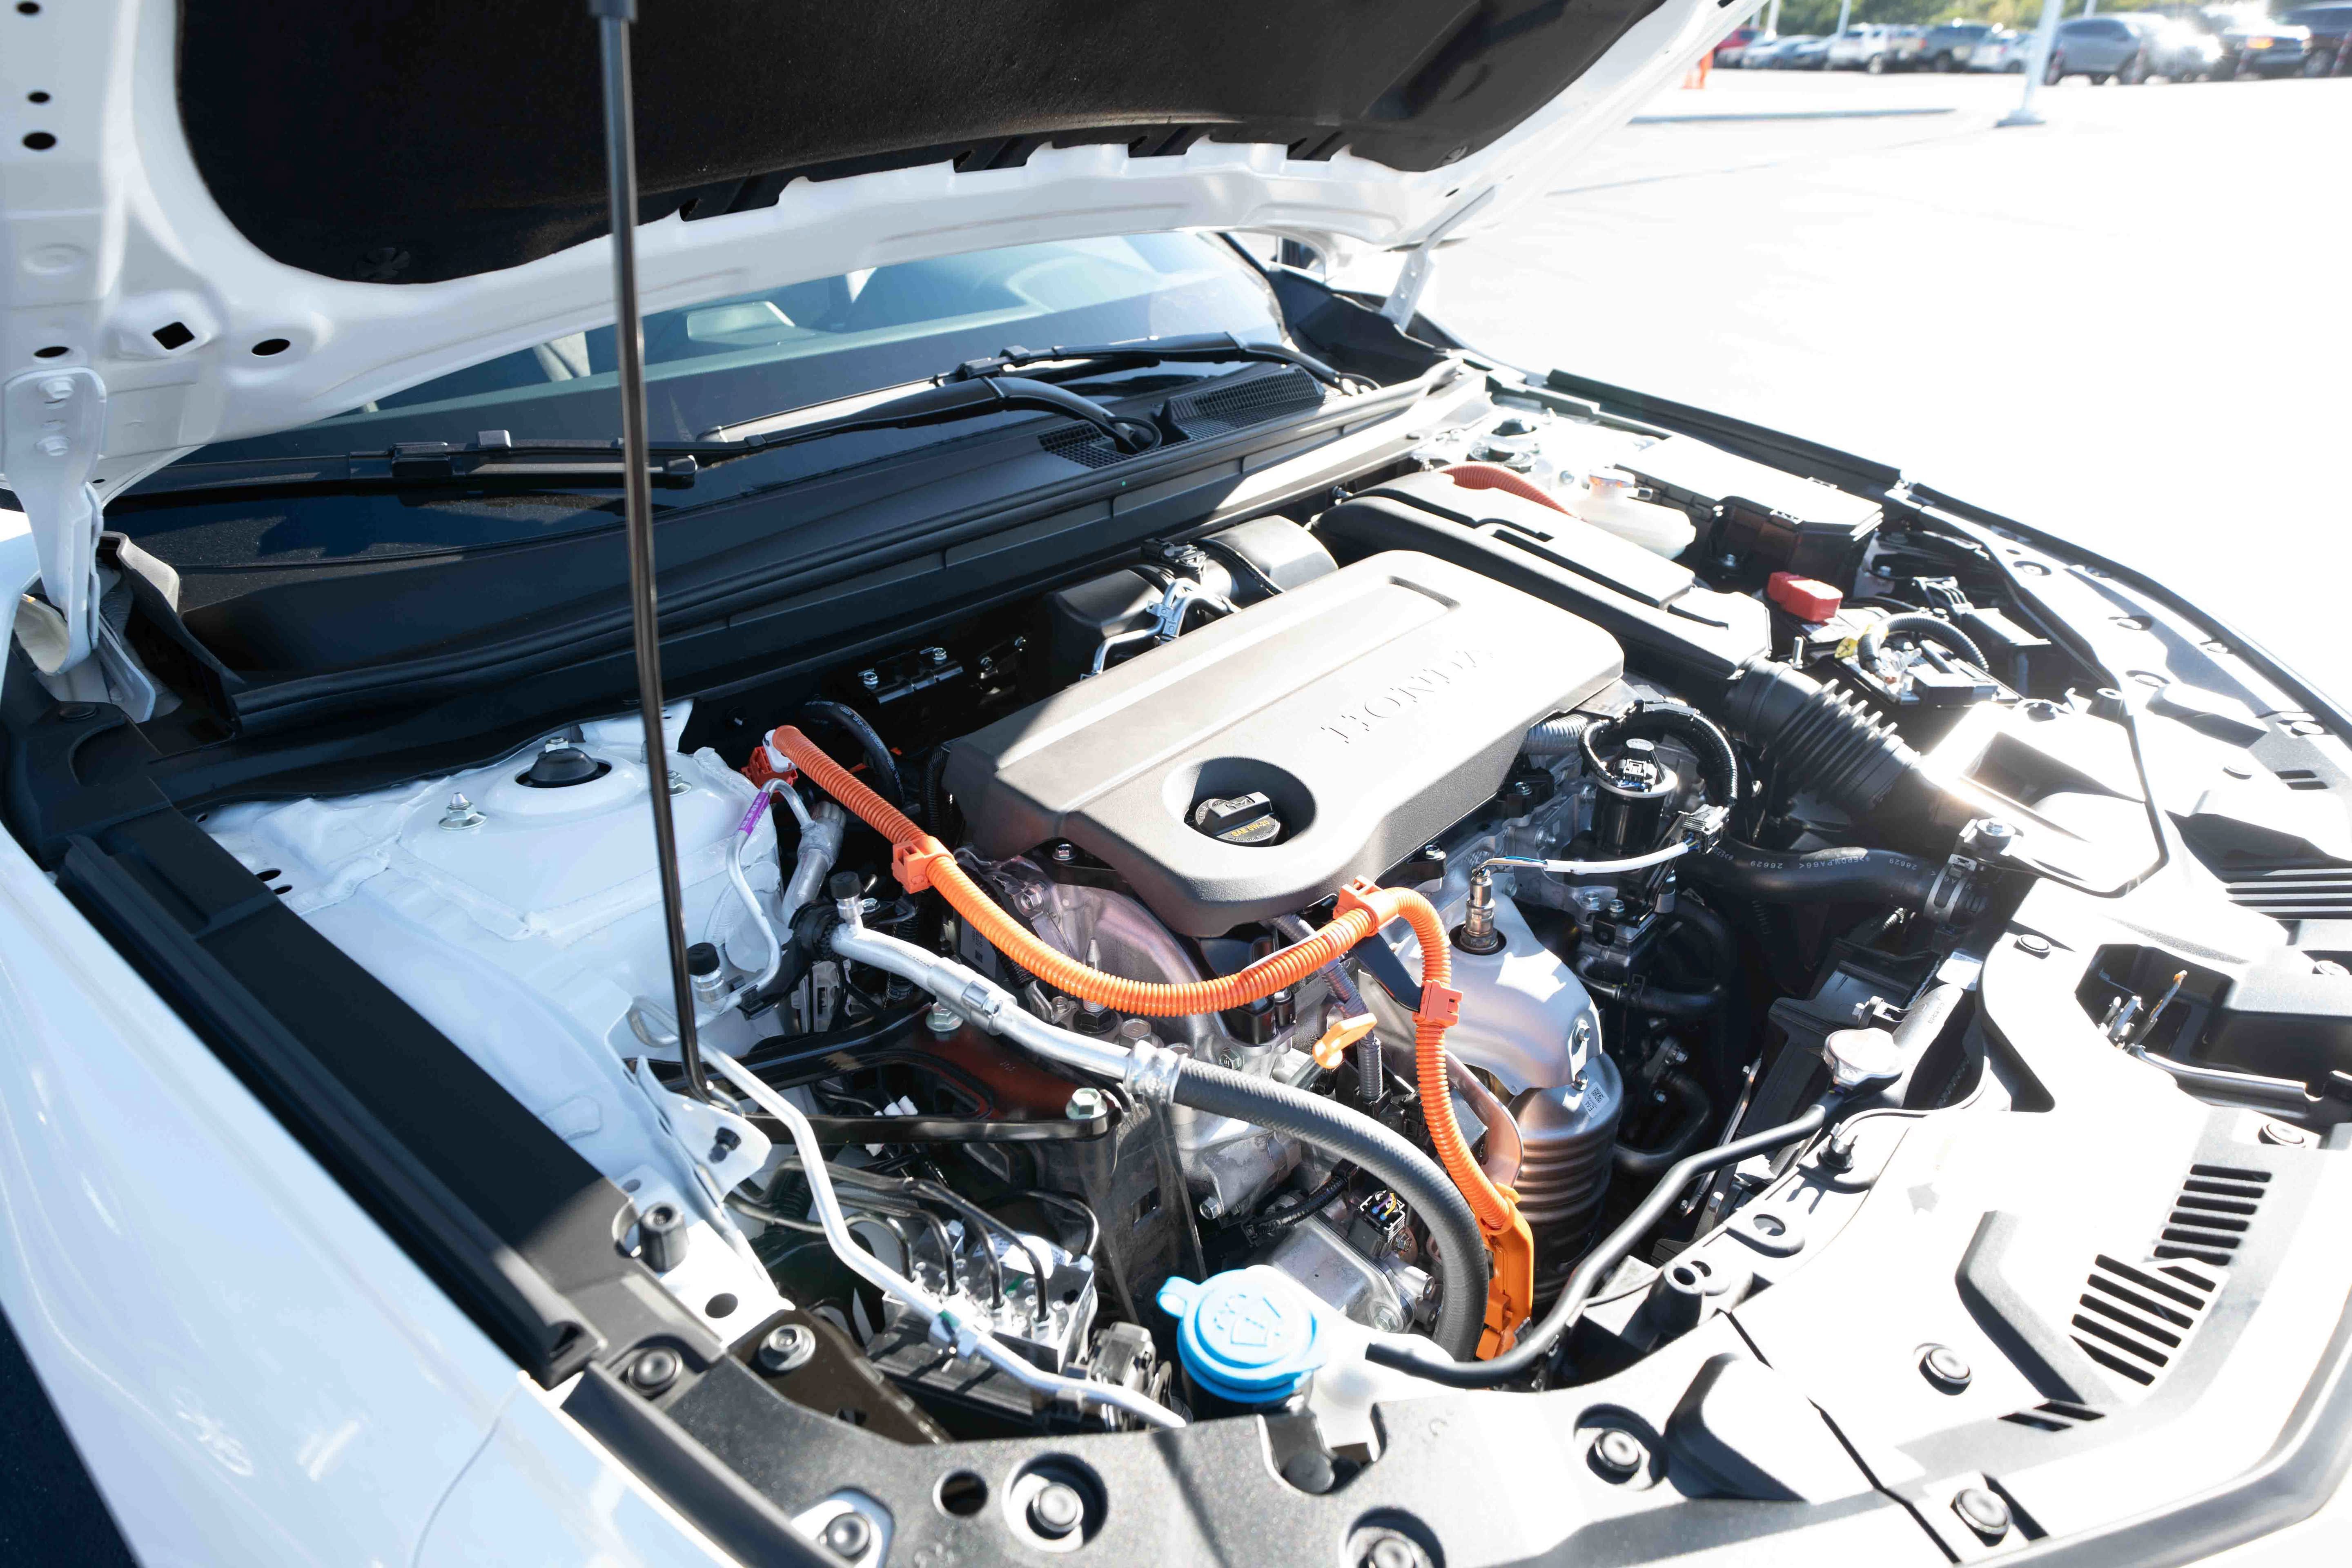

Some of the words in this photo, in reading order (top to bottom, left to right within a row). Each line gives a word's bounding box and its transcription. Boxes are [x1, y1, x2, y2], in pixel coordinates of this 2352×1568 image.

[1231, 828, 1249, 837] SAE
[1247, 820, 1270, 831] 0W-20
[1750, 860, 1784, 869] 26629
[1889, 858, 1918, 870] 26629
